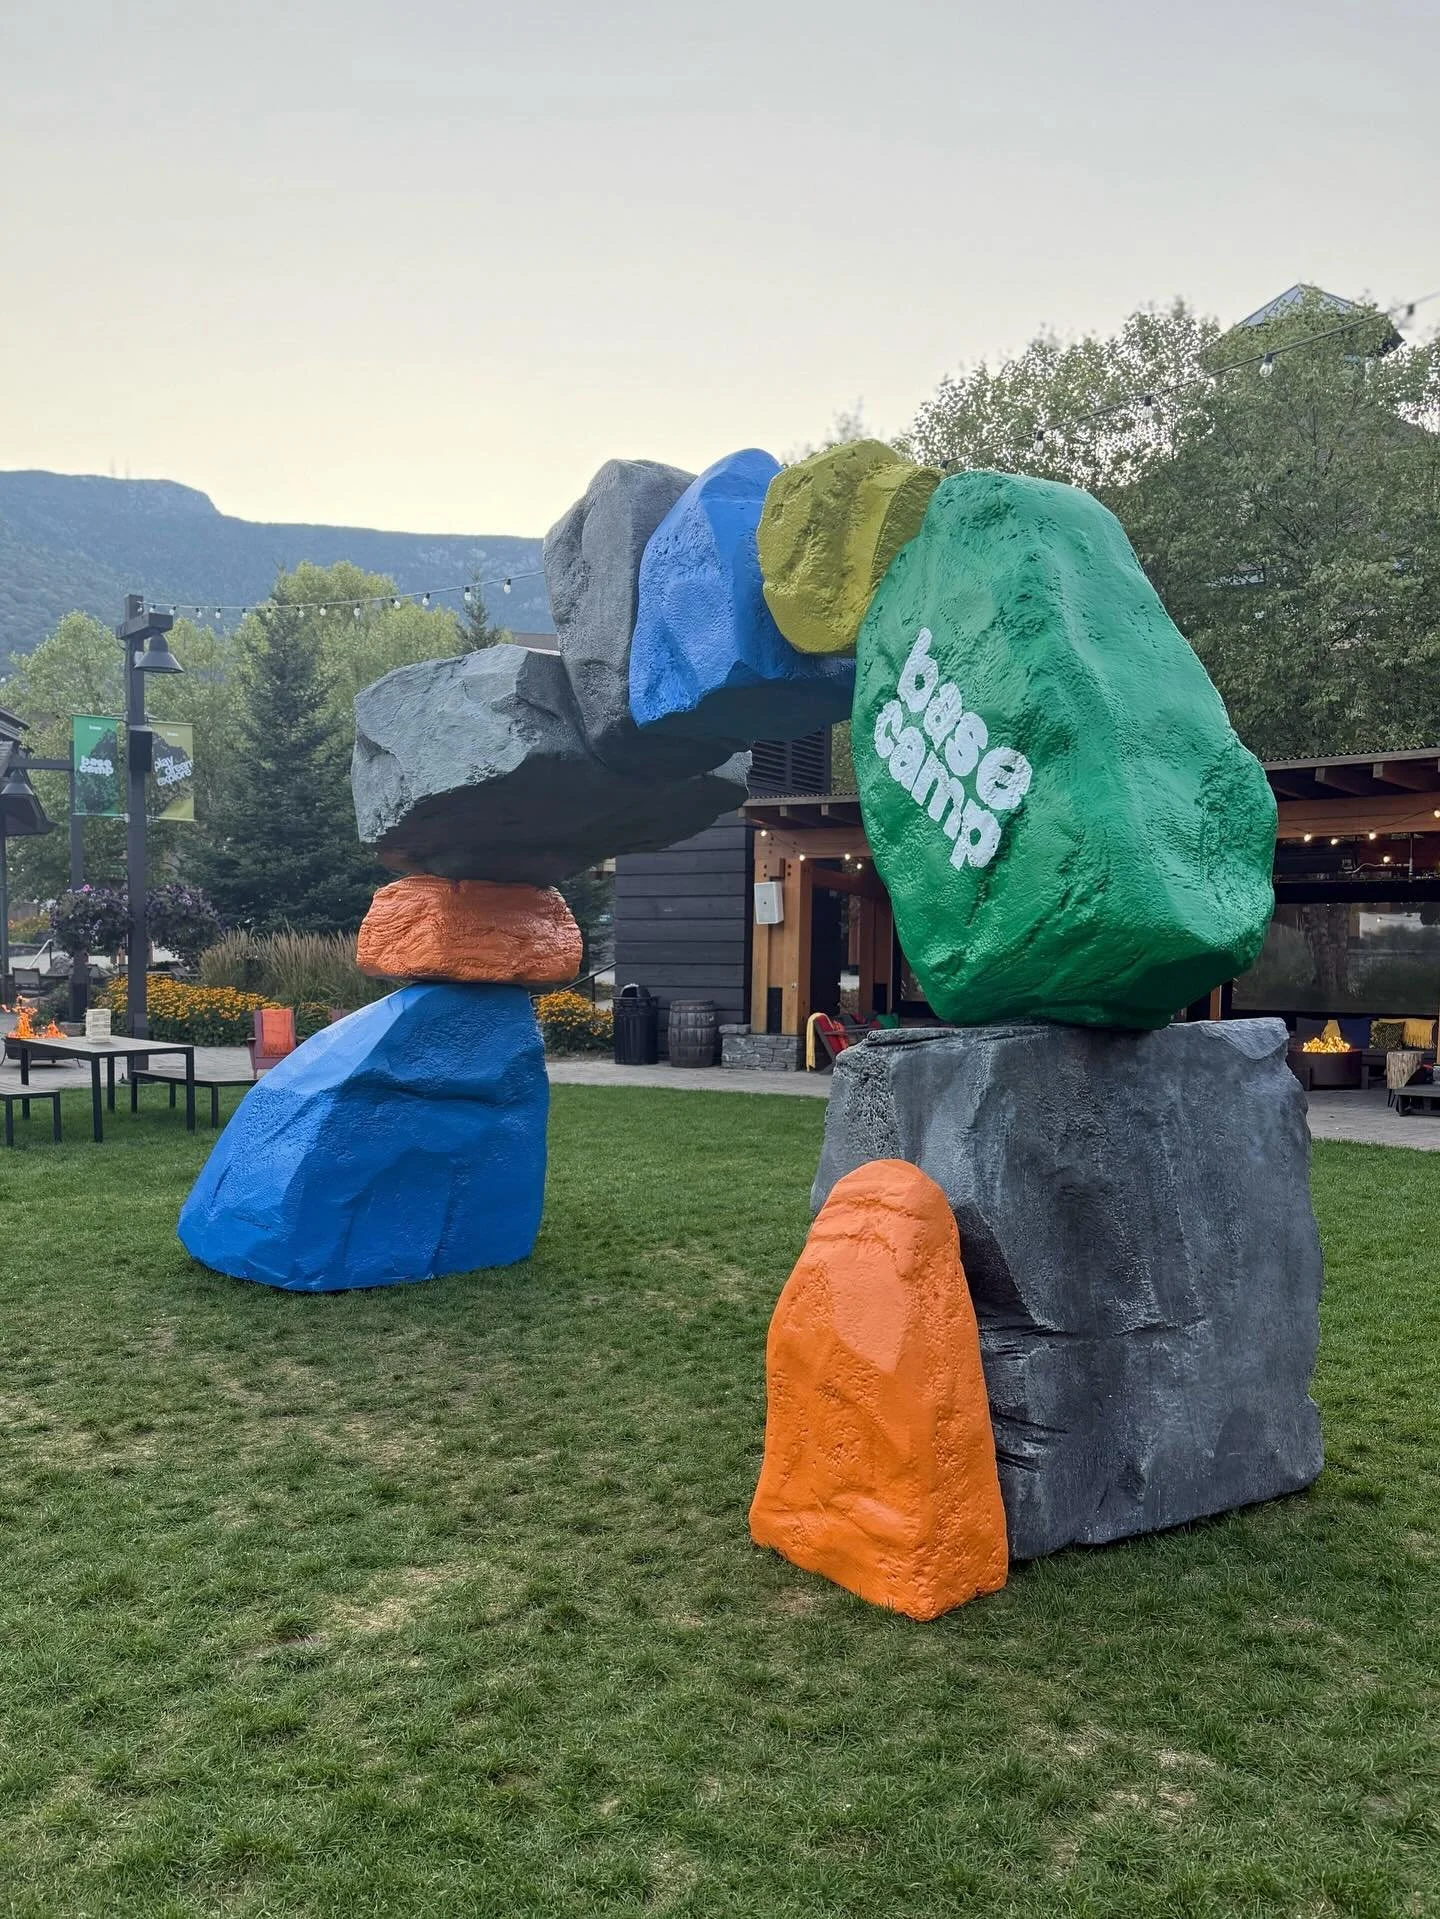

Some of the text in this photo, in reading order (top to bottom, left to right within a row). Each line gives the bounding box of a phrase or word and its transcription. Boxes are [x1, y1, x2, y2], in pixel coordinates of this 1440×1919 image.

[897, 627, 1033, 810] base
[79, 765, 114, 776] camp
[154, 756, 174, 772] play
[165, 760, 193, 777] dream
[157, 769, 192, 786] explore
[874, 700, 1002, 870] camp
